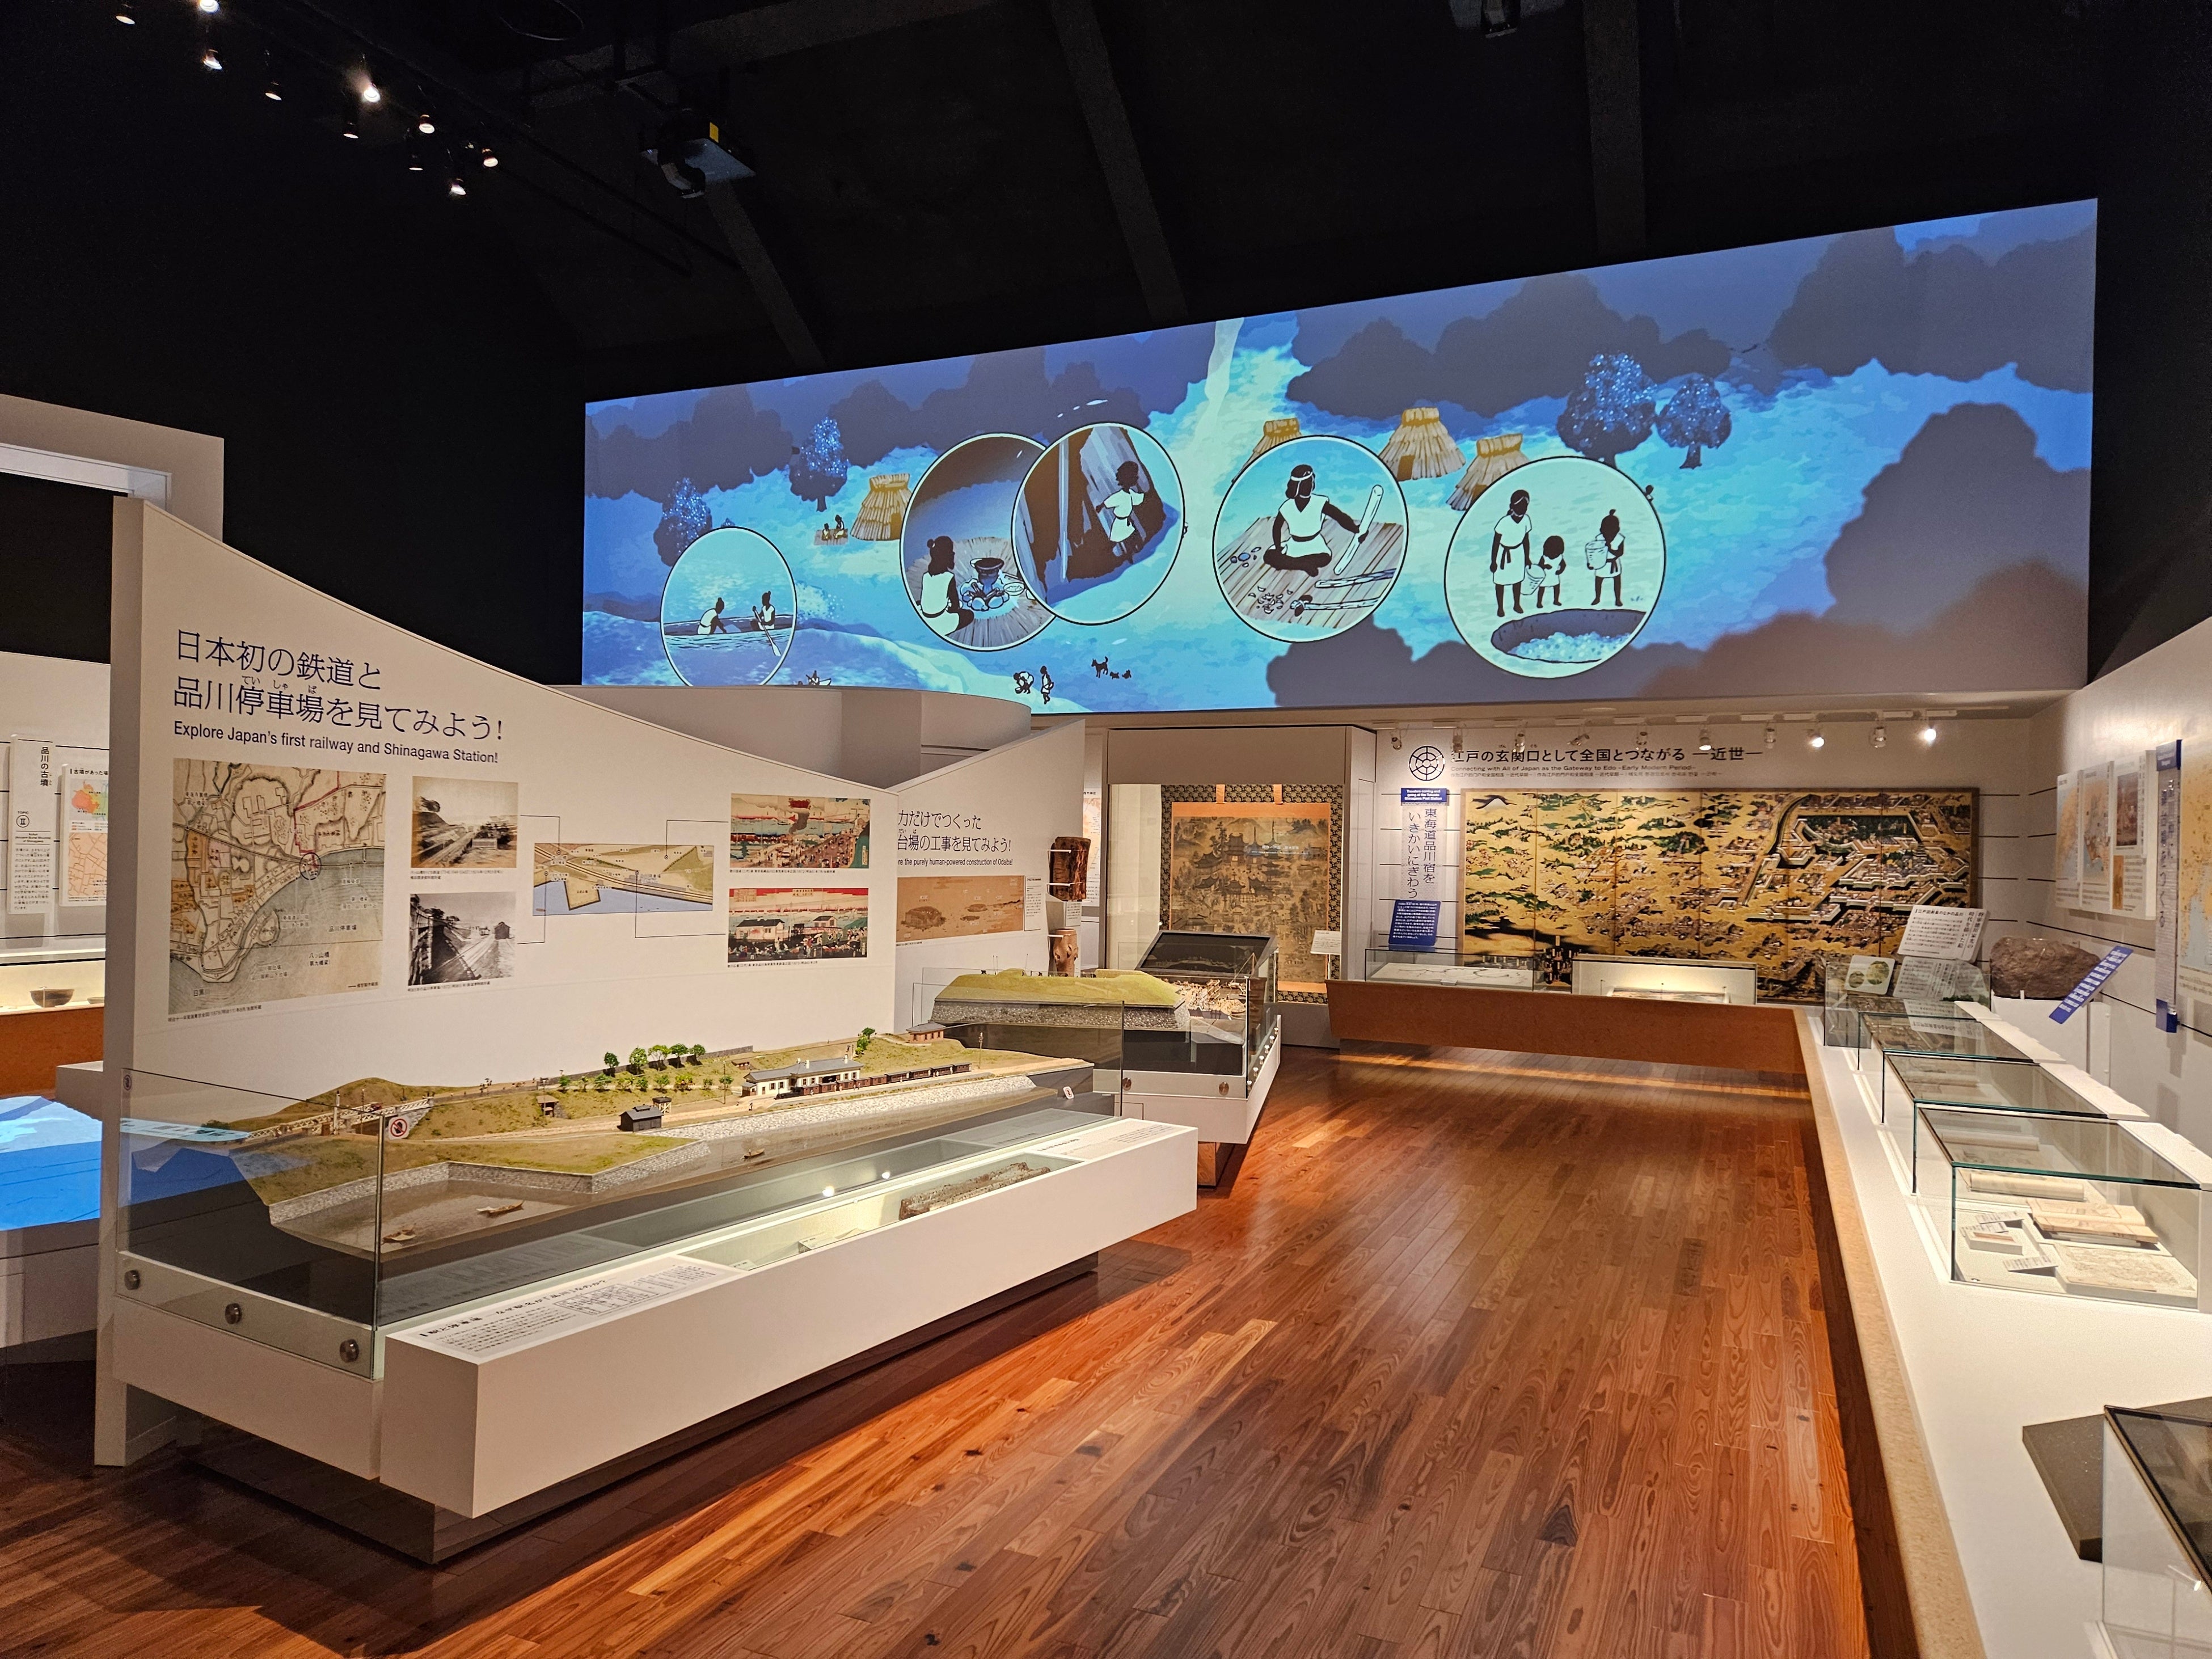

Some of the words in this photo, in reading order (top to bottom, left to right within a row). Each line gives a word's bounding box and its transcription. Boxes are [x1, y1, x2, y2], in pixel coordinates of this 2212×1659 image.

[178, 629, 381, 690] 日本初の鉄道と
[174, 676, 502, 740] 品川停車場を見てみよう！
[174, 720, 223, 740] Explore
[227, 727, 277, 746] Japan’s
[281, 732, 306, 748] first
[310, 737, 353, 754] railway
[357, 742, 379, 753] and
[384, 742, 449, 760] Shinagawa
[453, 749, 498, 763] Station!
[1450, 748, 1686, 763] 江戸の玄関口として全国とつながる
[40, 746, 49, 787] 品川の古墳
[898, 809, 981, 830] 力だけでつくった
[897, 834, 1011, 853] 台場の工事を見てみよう！
[913, 858, 928, 867] purely
[929, 858, 965, 866] human-powered
[1407, 812, 1421, 899] いきかいにぎわう
[1422, 808, 1437, 884] 東海道品川宿を
